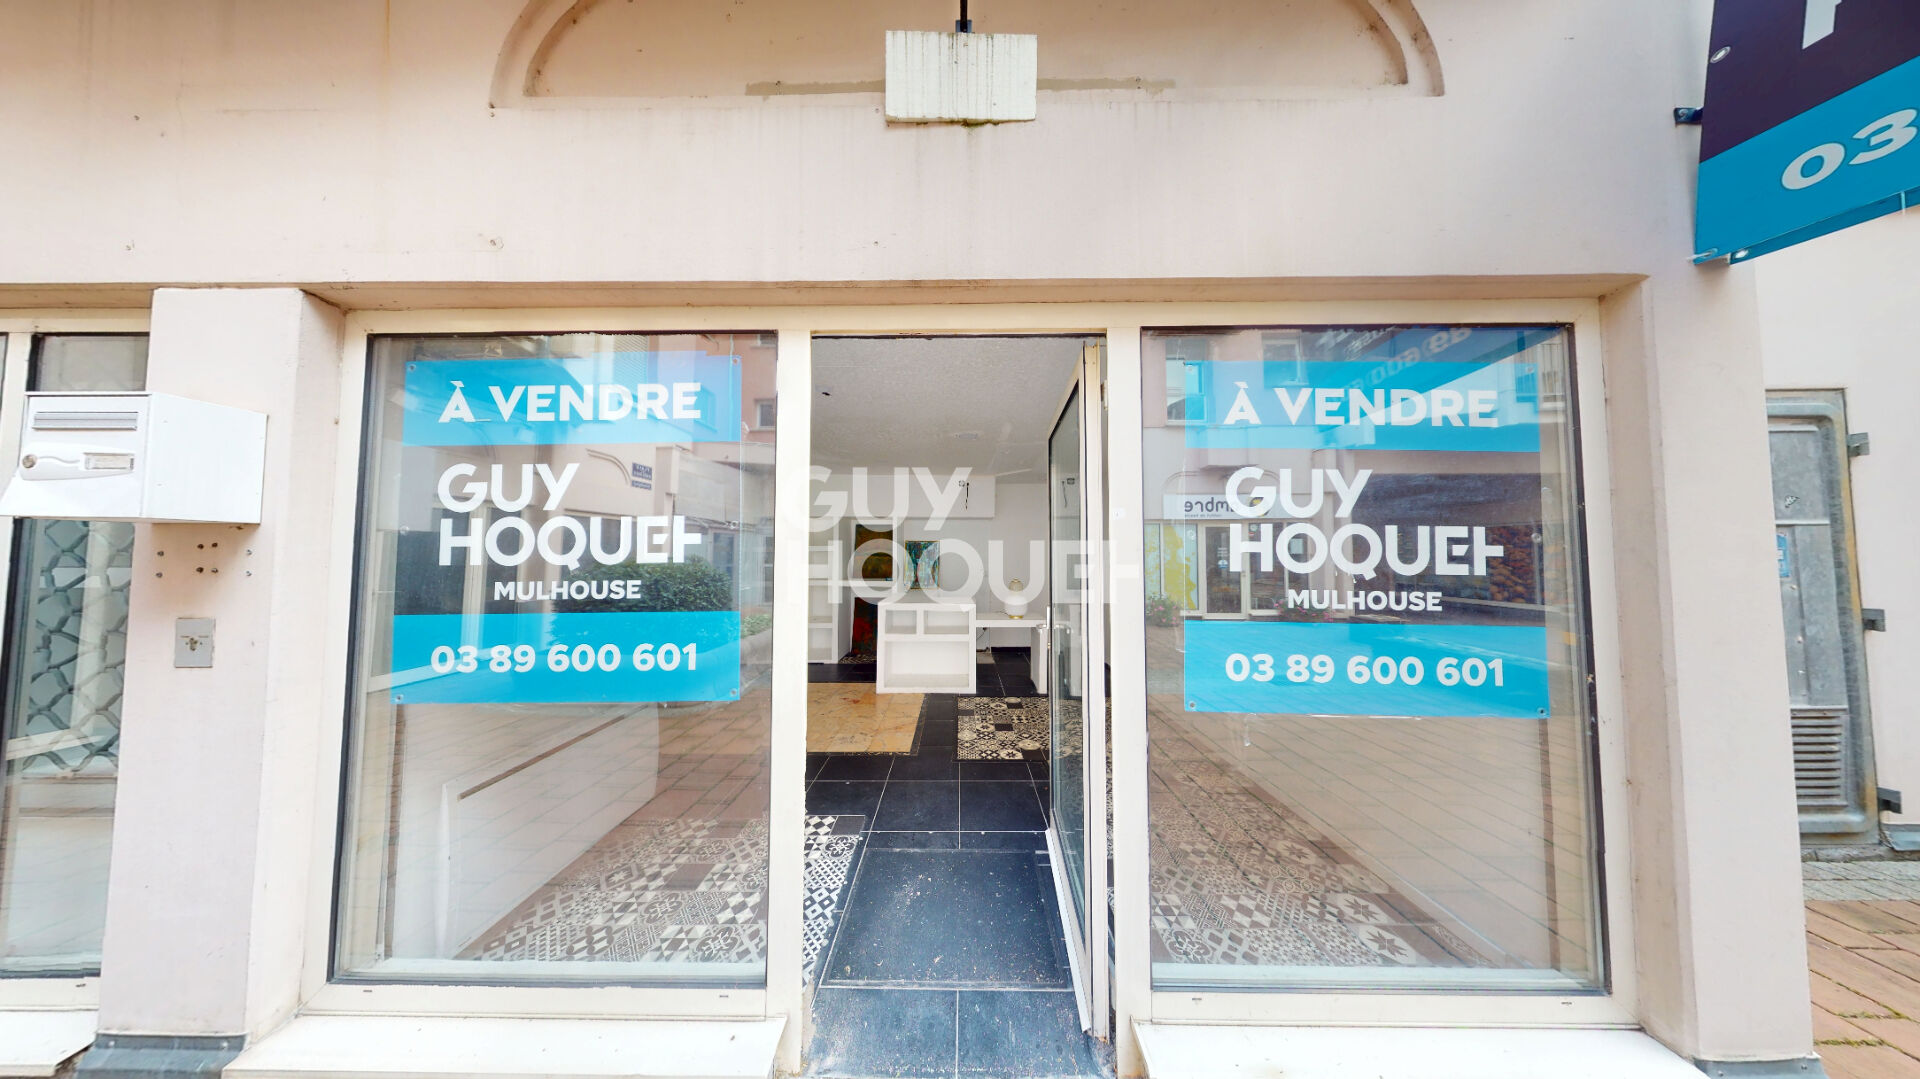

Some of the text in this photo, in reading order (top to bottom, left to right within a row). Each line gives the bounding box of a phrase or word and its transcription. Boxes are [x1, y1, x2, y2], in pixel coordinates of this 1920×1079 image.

[1781, 108, 1918, 190] 03
[438, 380, 701, 424] À VENDRE
[1223, 381, 1499, 427] À VENDRE
[437, 462, 580, 513] GUY
[1224, 466, 1373, 518] GUY
[438, 515, 702, 571] HOQUET
[1229, 522, 1504, 581] HOQUET
[493, 579, 642, 601] MULHOUSE
[1287, 588, 1443, 612] MULHOUSE
[430, 641, 697, 674] 03 89 600 601
[1225, 652, 1504, 687] 03 89 600 601
